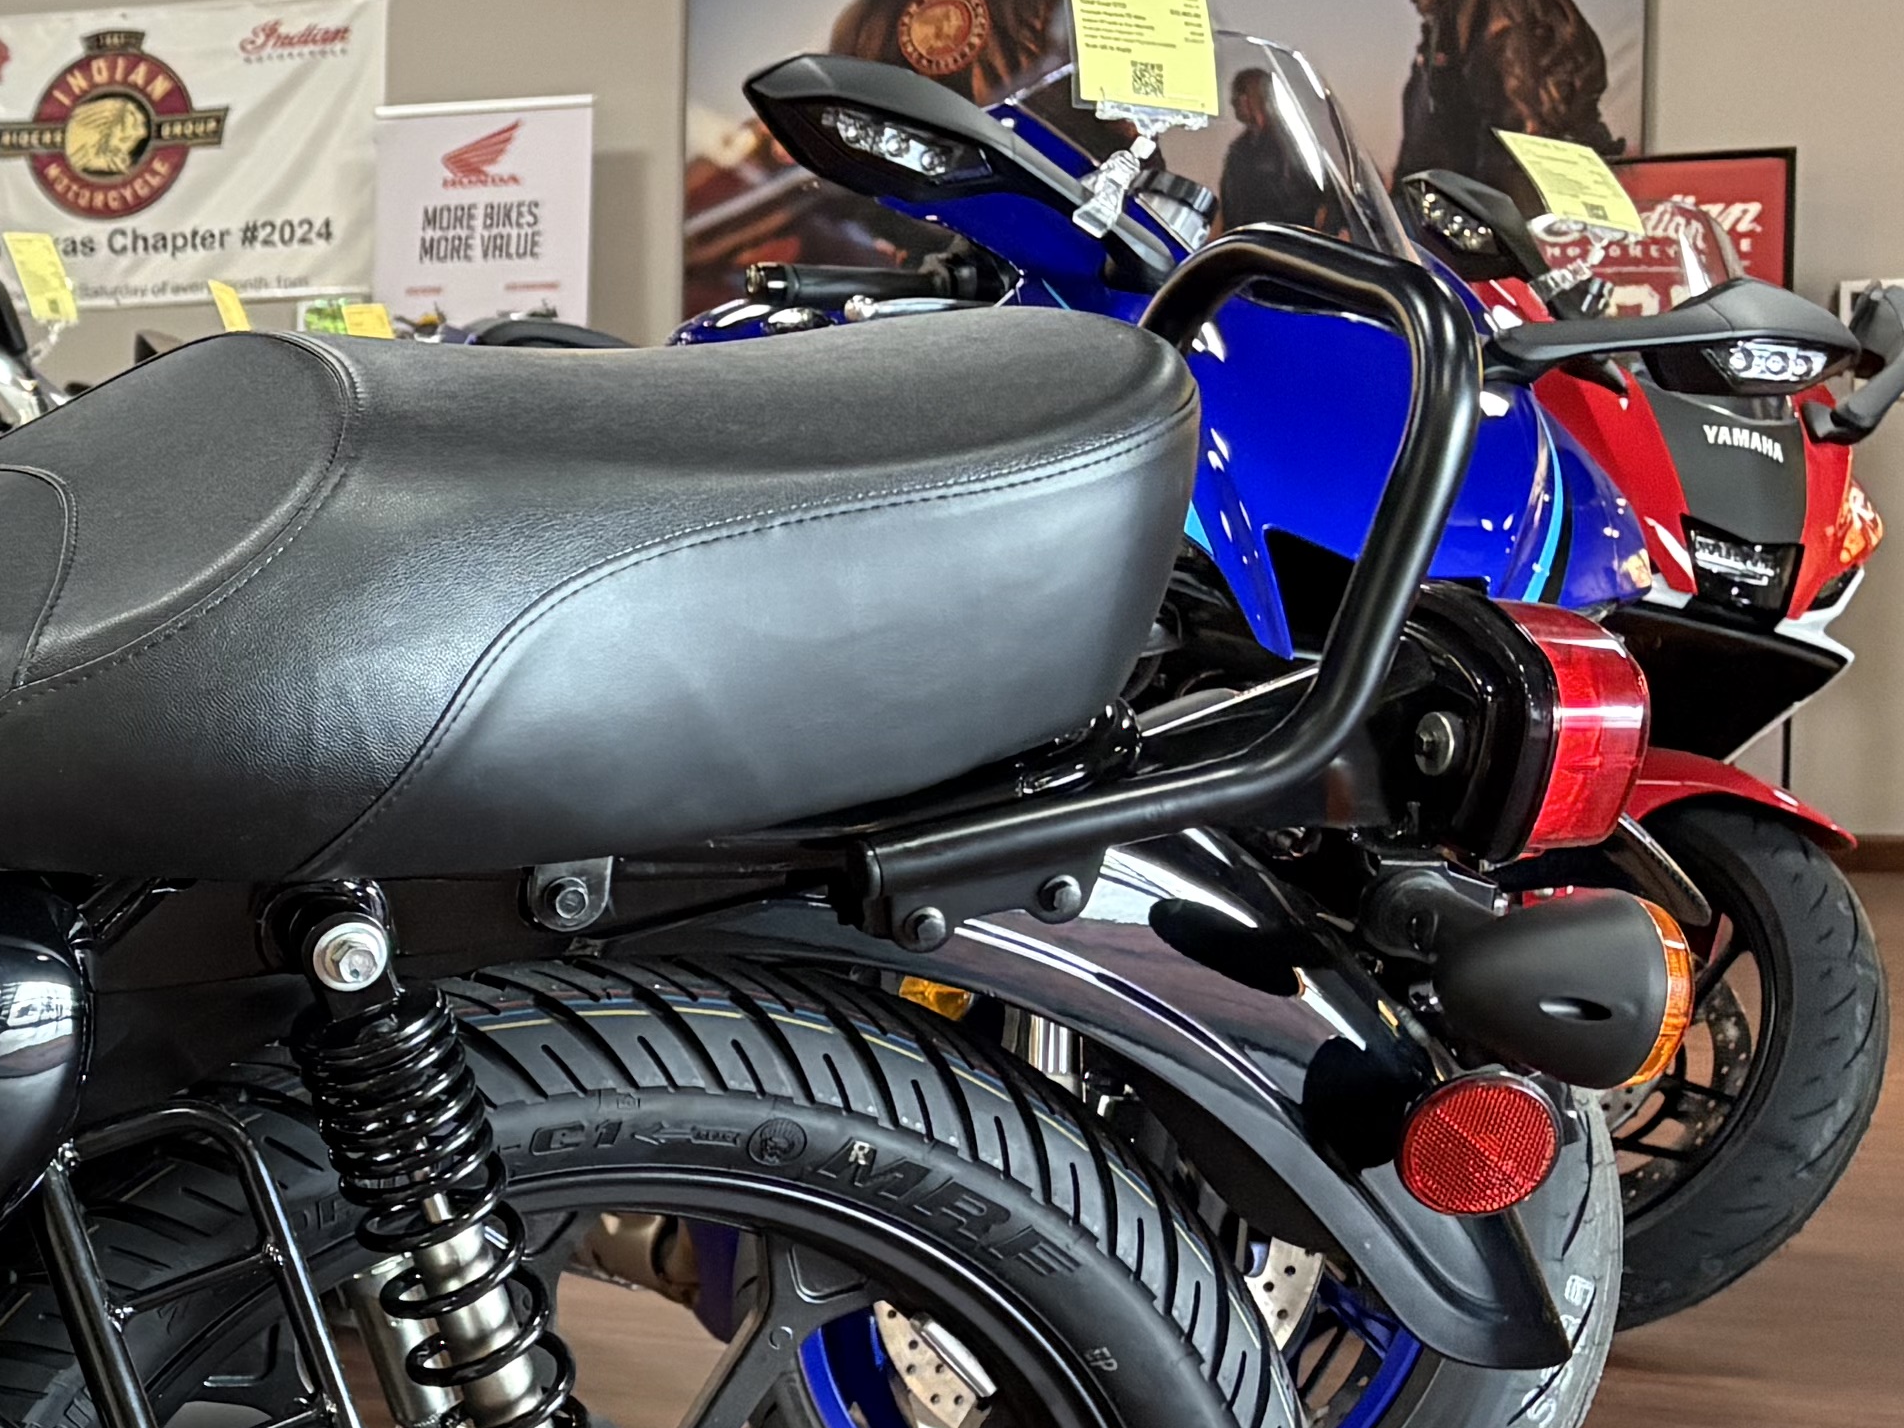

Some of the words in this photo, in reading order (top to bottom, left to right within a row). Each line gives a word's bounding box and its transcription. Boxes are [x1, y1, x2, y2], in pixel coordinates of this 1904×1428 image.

[52, 56, 174, 107] INDIAN
[43, 157, 171, 210] MOTORCYCLE
[441, 174, 522, 190] HONDA
[422, 203, 478, 232] MORE
[482, 201, 540, 230] BIKES
[106, 227, 230, 259] Chapter
[240, 216, 335, 247] #2024
[419, 234, 475, 263] MORE
[480, 231, 541, 262] VALUE
[1703, 424, 1784, 463] YAMAHA
[812, 1135, 1083, 1278] MRF
